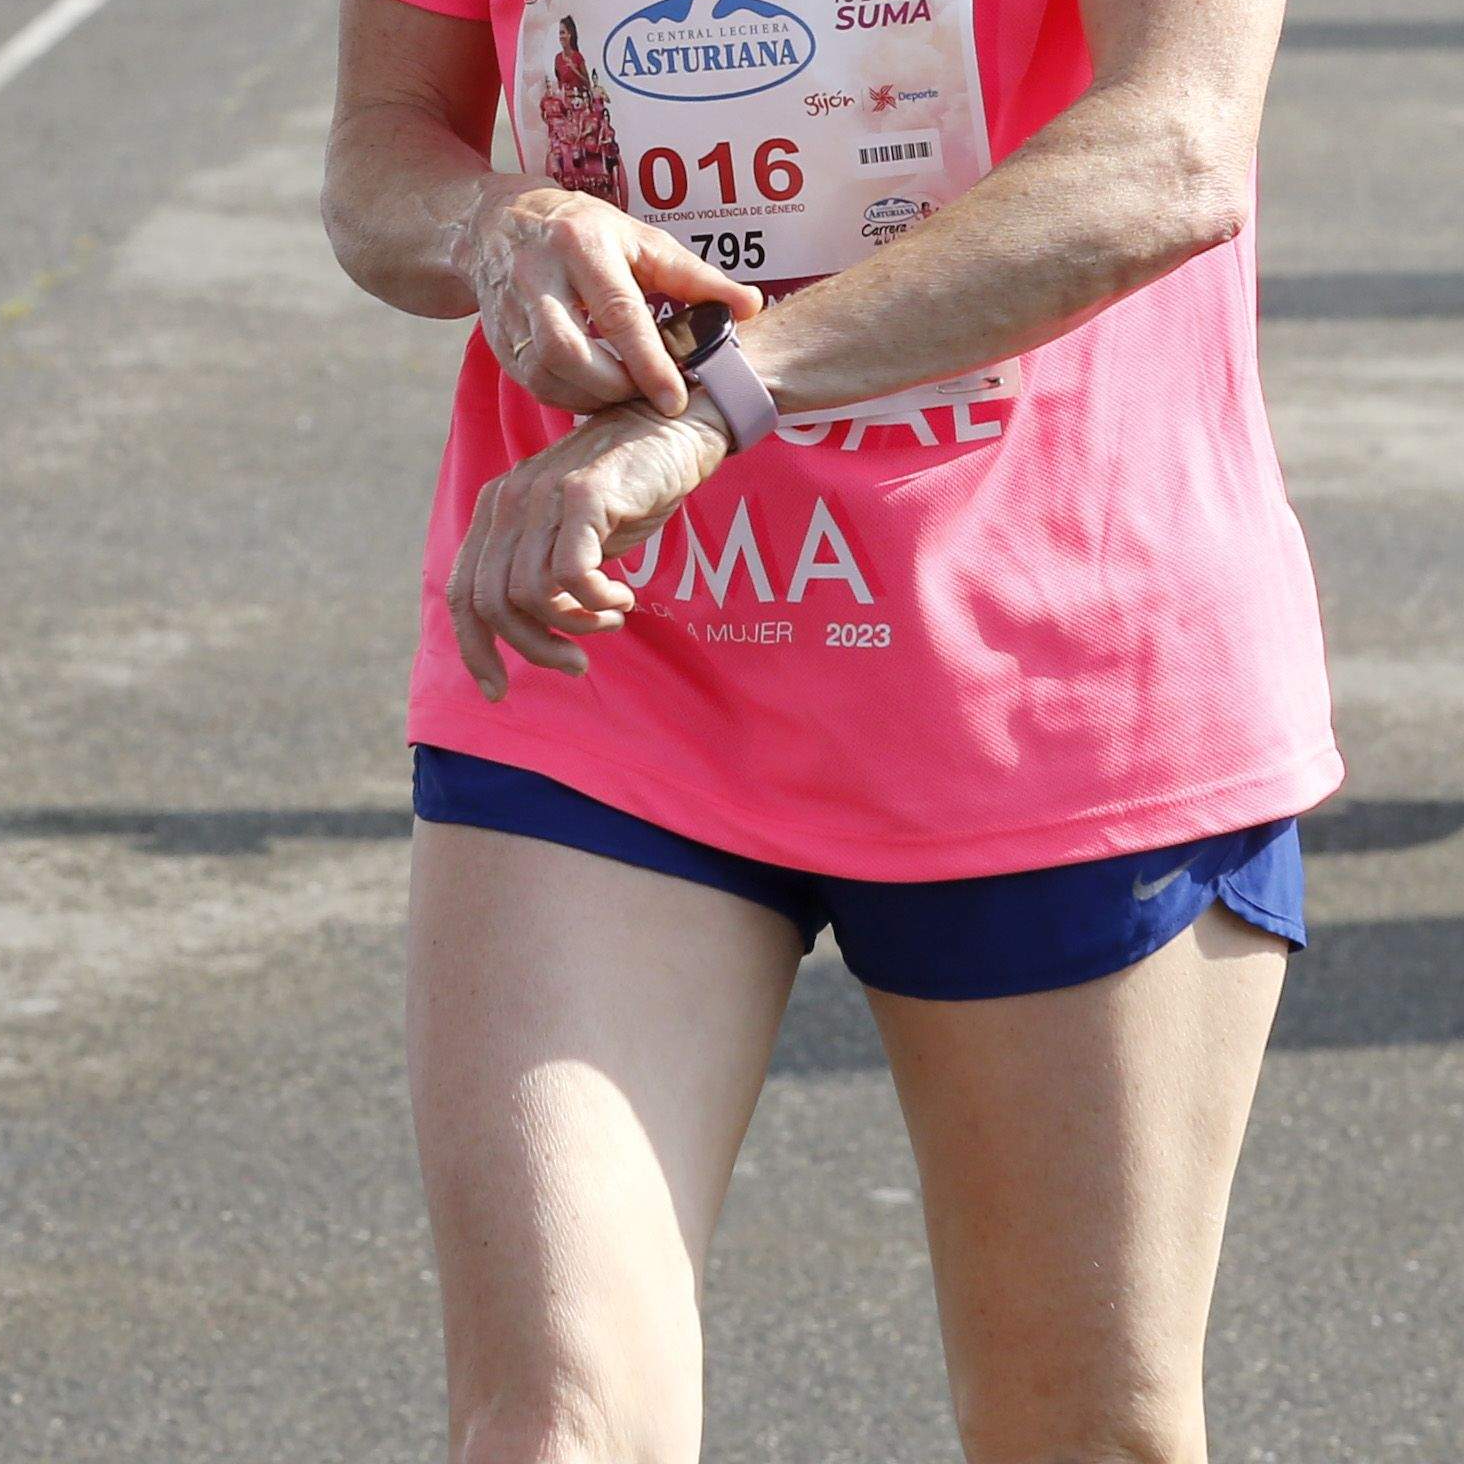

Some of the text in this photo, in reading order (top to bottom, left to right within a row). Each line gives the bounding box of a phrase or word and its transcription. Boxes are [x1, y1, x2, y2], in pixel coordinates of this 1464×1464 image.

[646, 22, 790, 43] CENTRAL LECHERA
[618, 36, 800, 78] ASTURIANA
[803, 87, 939, 117] gijón Deporte
[638, 138, 804, 211] 016
[643, 202, 806, 224] TELÉFONO VIOLENCIA DE GÉNERO
[690, 230, 766, 271] 795
[706, 621, 793, 644] MUJER
[824, 623, 892, 647] 2023
